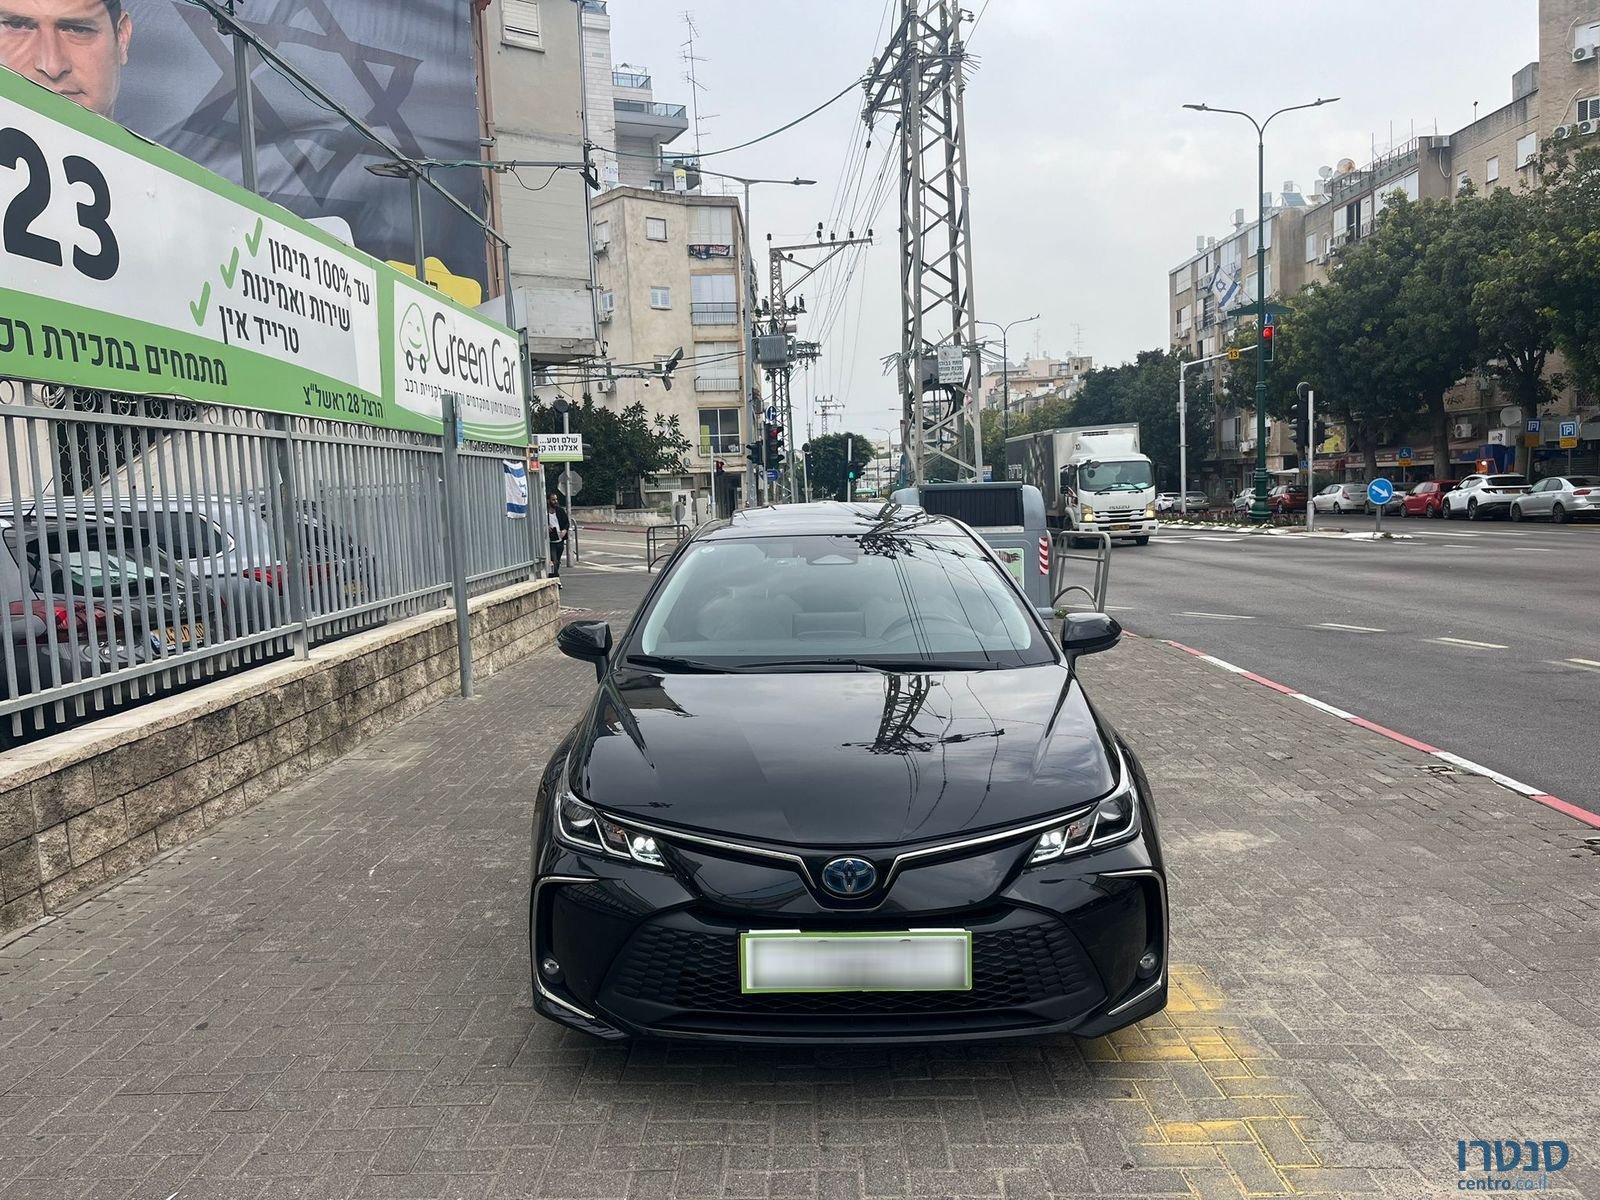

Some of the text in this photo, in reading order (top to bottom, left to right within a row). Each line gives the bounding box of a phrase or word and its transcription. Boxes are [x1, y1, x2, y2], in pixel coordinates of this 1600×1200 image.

[268, 238, 370, 305] עד 100% מימון
[241, 268, 351, 332] שירות ואמינות
[41, 324, 141, 372] במכירת
[218, 305, 300, 353] טרייד אין
[144, 343, 228, 386] מתמחים
[432, 311, 516, 395] Green Car
[1230, 350, 1238, 358] 13
[303, 383, 384, 419] הרצל 28 ראשל"צ
[404, 378, 419, 394] רכב
[561, 436, 578, 444] שלם
